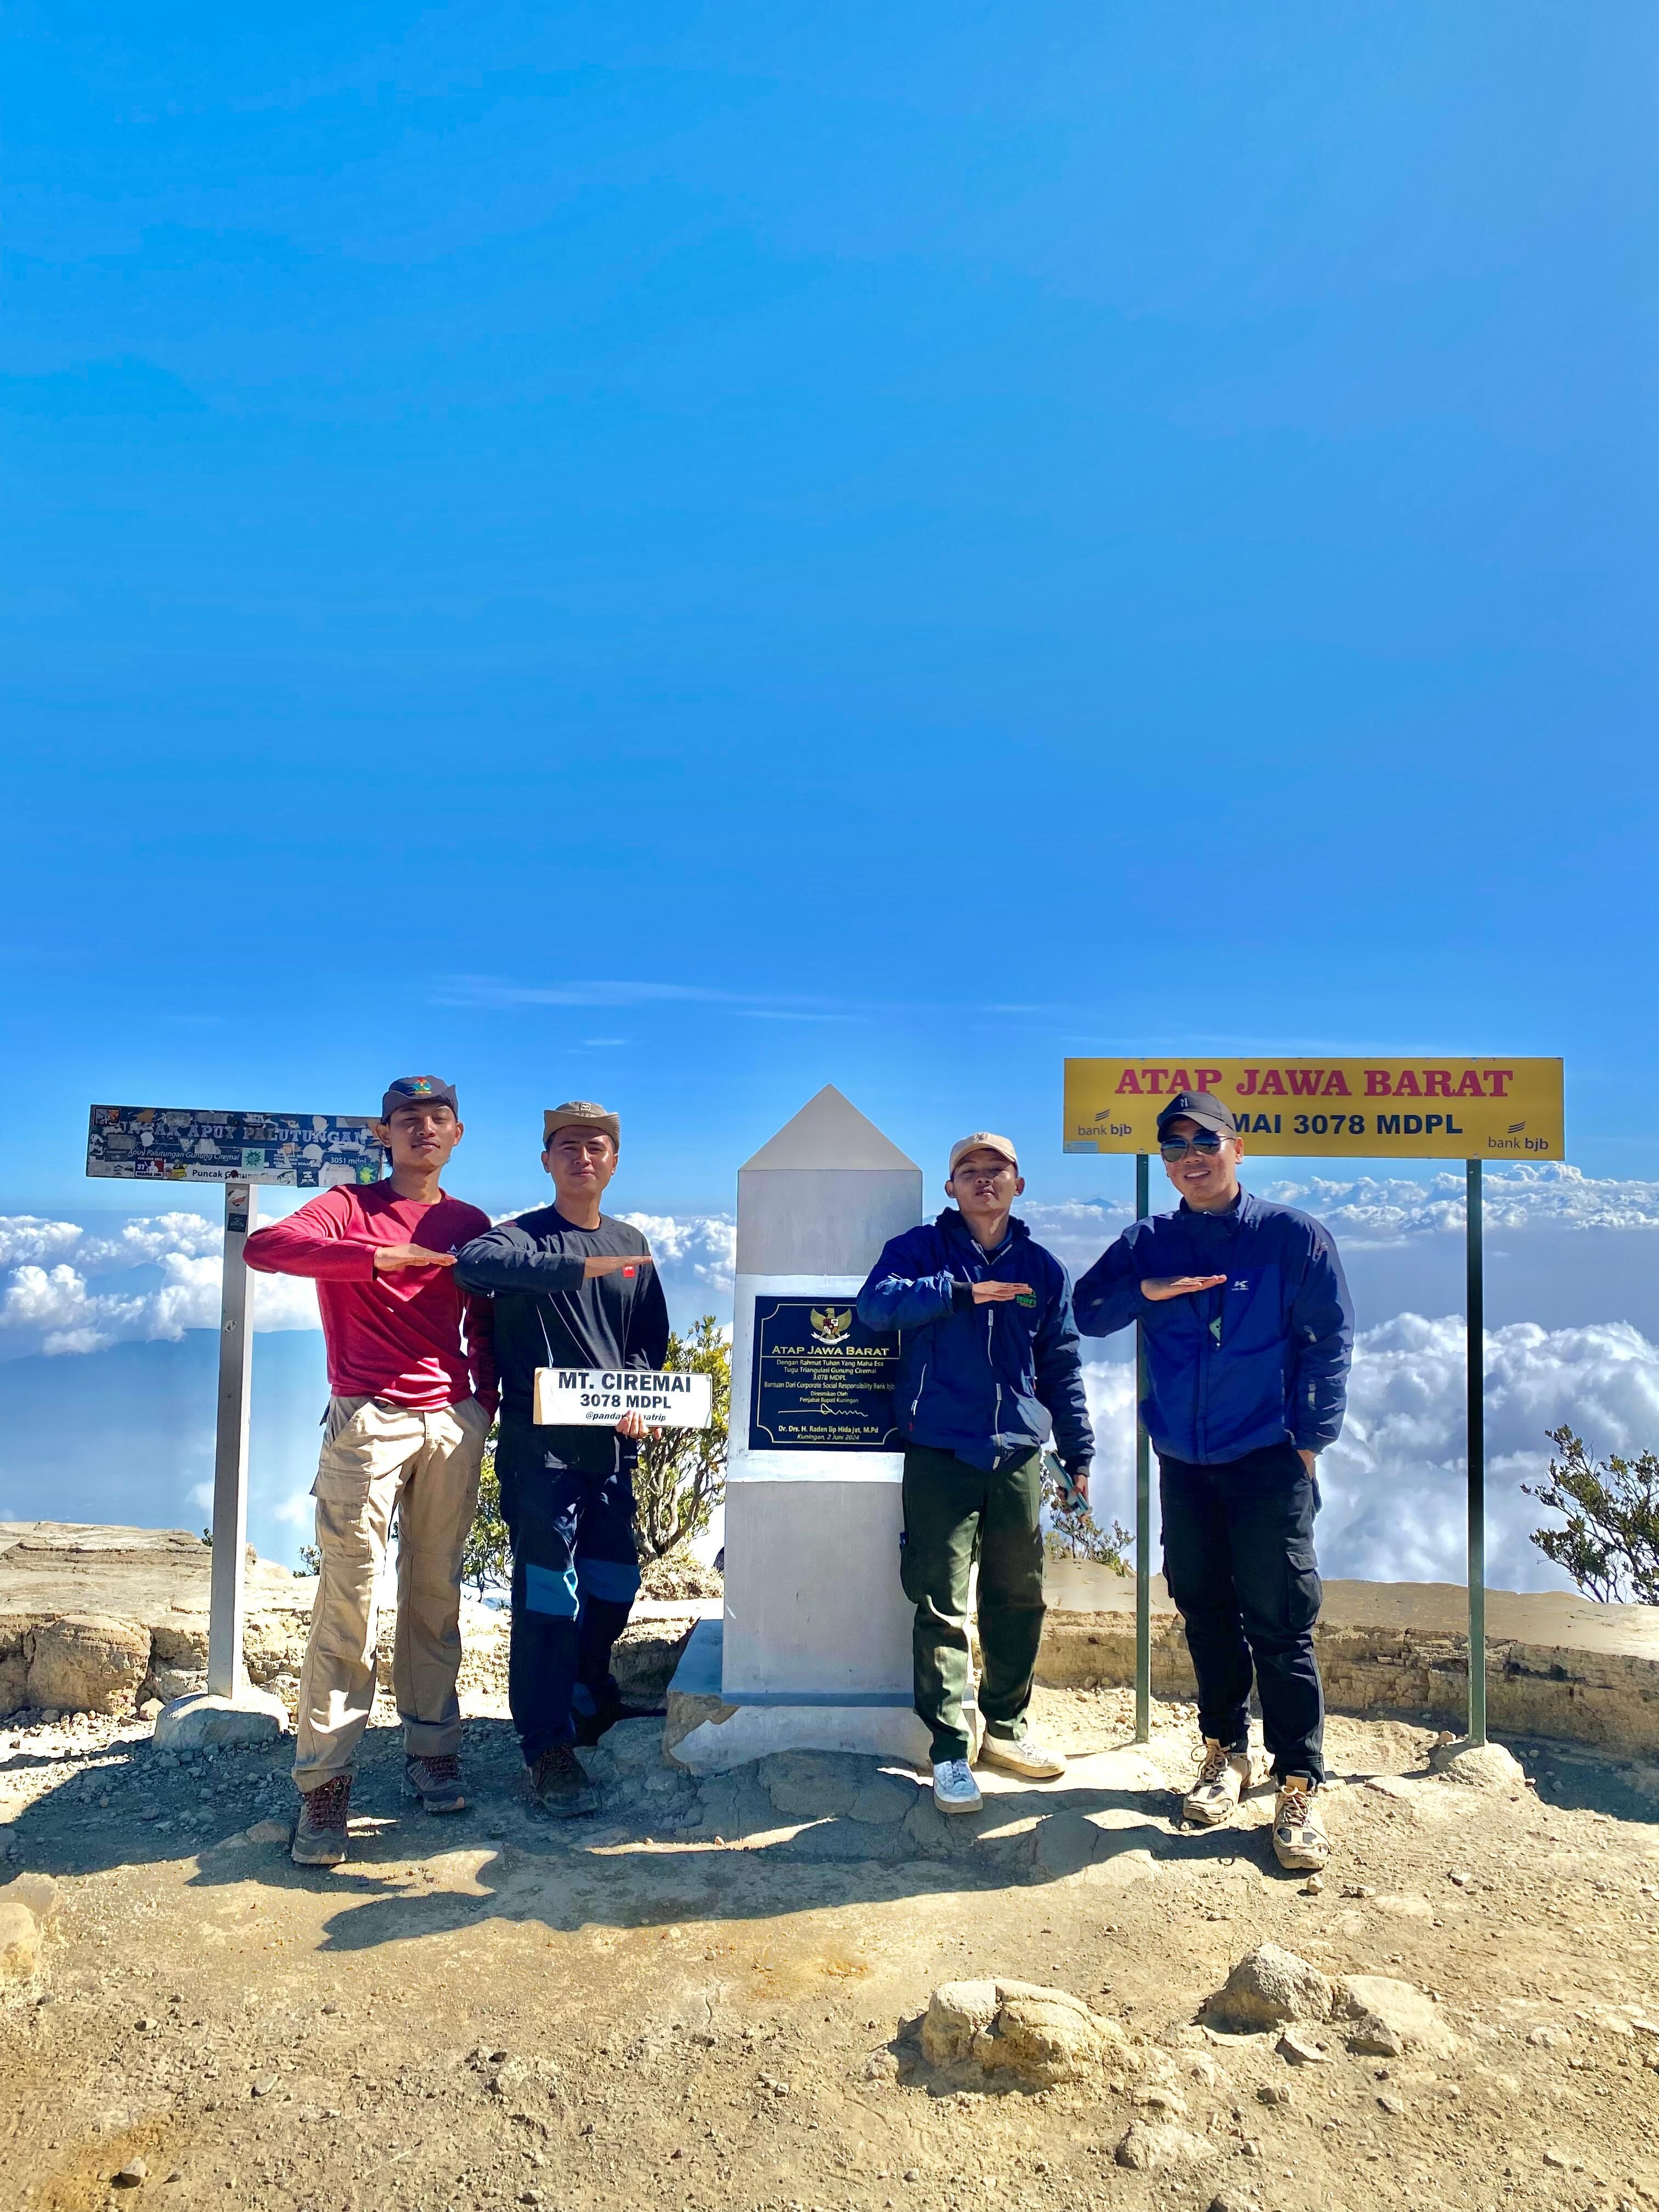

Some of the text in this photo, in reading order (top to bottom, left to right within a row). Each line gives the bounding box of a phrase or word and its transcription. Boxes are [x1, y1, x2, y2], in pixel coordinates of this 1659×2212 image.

[1115, 1069, 1513, 1097] ATAP JAWA BARAT
[1078, 1124, 1132, 1136] bank bjb
[1294, 1115, 1365, 1134] 3078
[1377, 1115, 1463, 1134] MDPL
[188, 1125, 236, 1139] APUY
[243, 1127, 366, 1144] PALUTUNGAN
[1488, 1137, 1549, 1152] bank bjb
[146, 1149, 184, 1159] Palutungan
[185, 1152, 212, 1160] Gunung
[193, 1170, 223, 1178] Puncak
[772, 1346, 889, 1356] ATAP JAWA BARAT
[558, 1372, 690, 1392] MT. CIREMAI
[580, 1394, 672, 1409] 3078 MDPL
